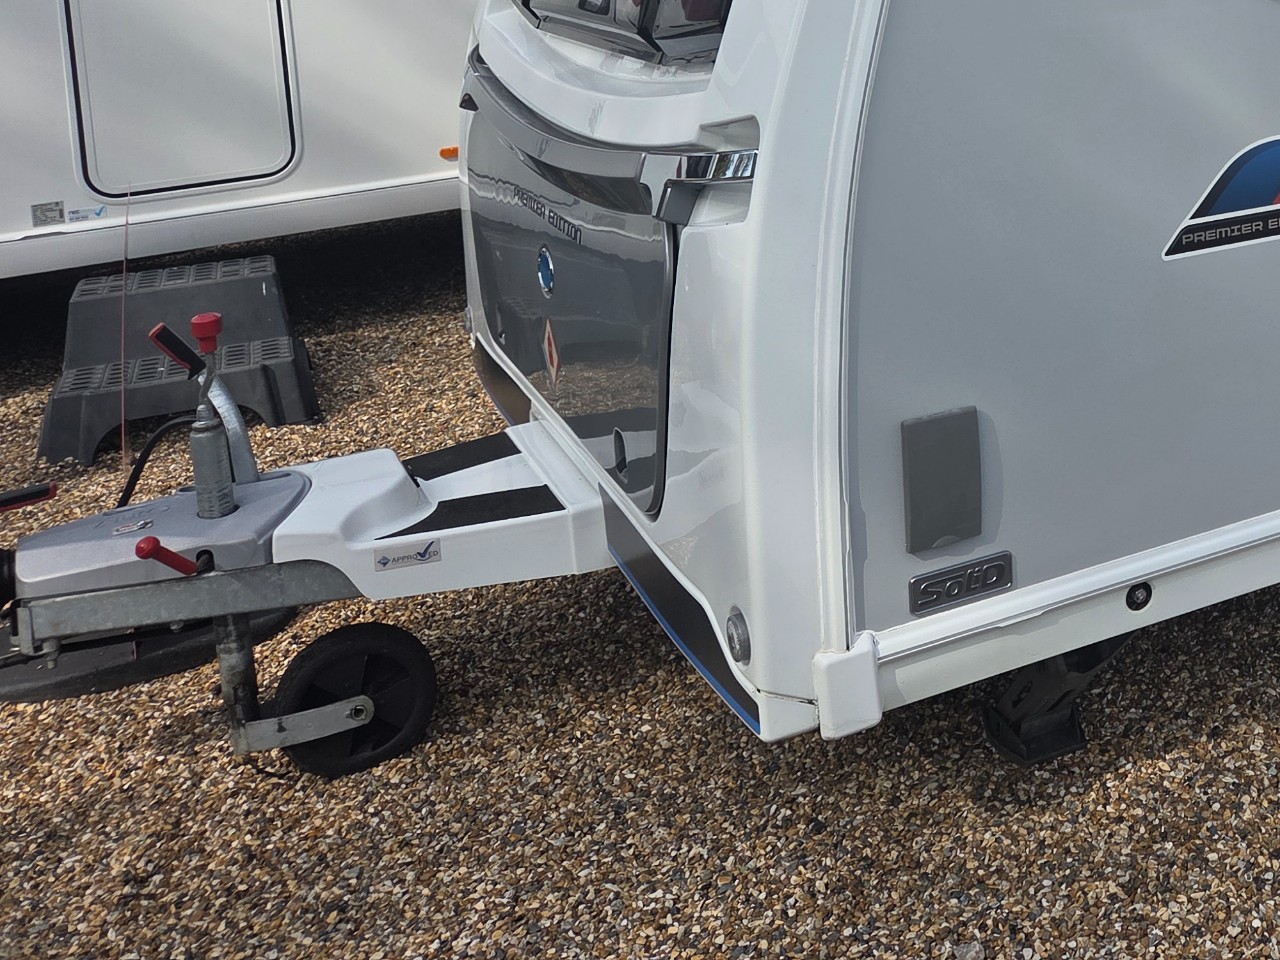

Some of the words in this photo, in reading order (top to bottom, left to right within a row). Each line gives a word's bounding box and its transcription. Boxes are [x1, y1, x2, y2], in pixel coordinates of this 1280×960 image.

[514, 186, 546, 220] PREMIER
[547, 208, 582, 245] EDITION
[1182, 221, 1264, 246] PREMIER
